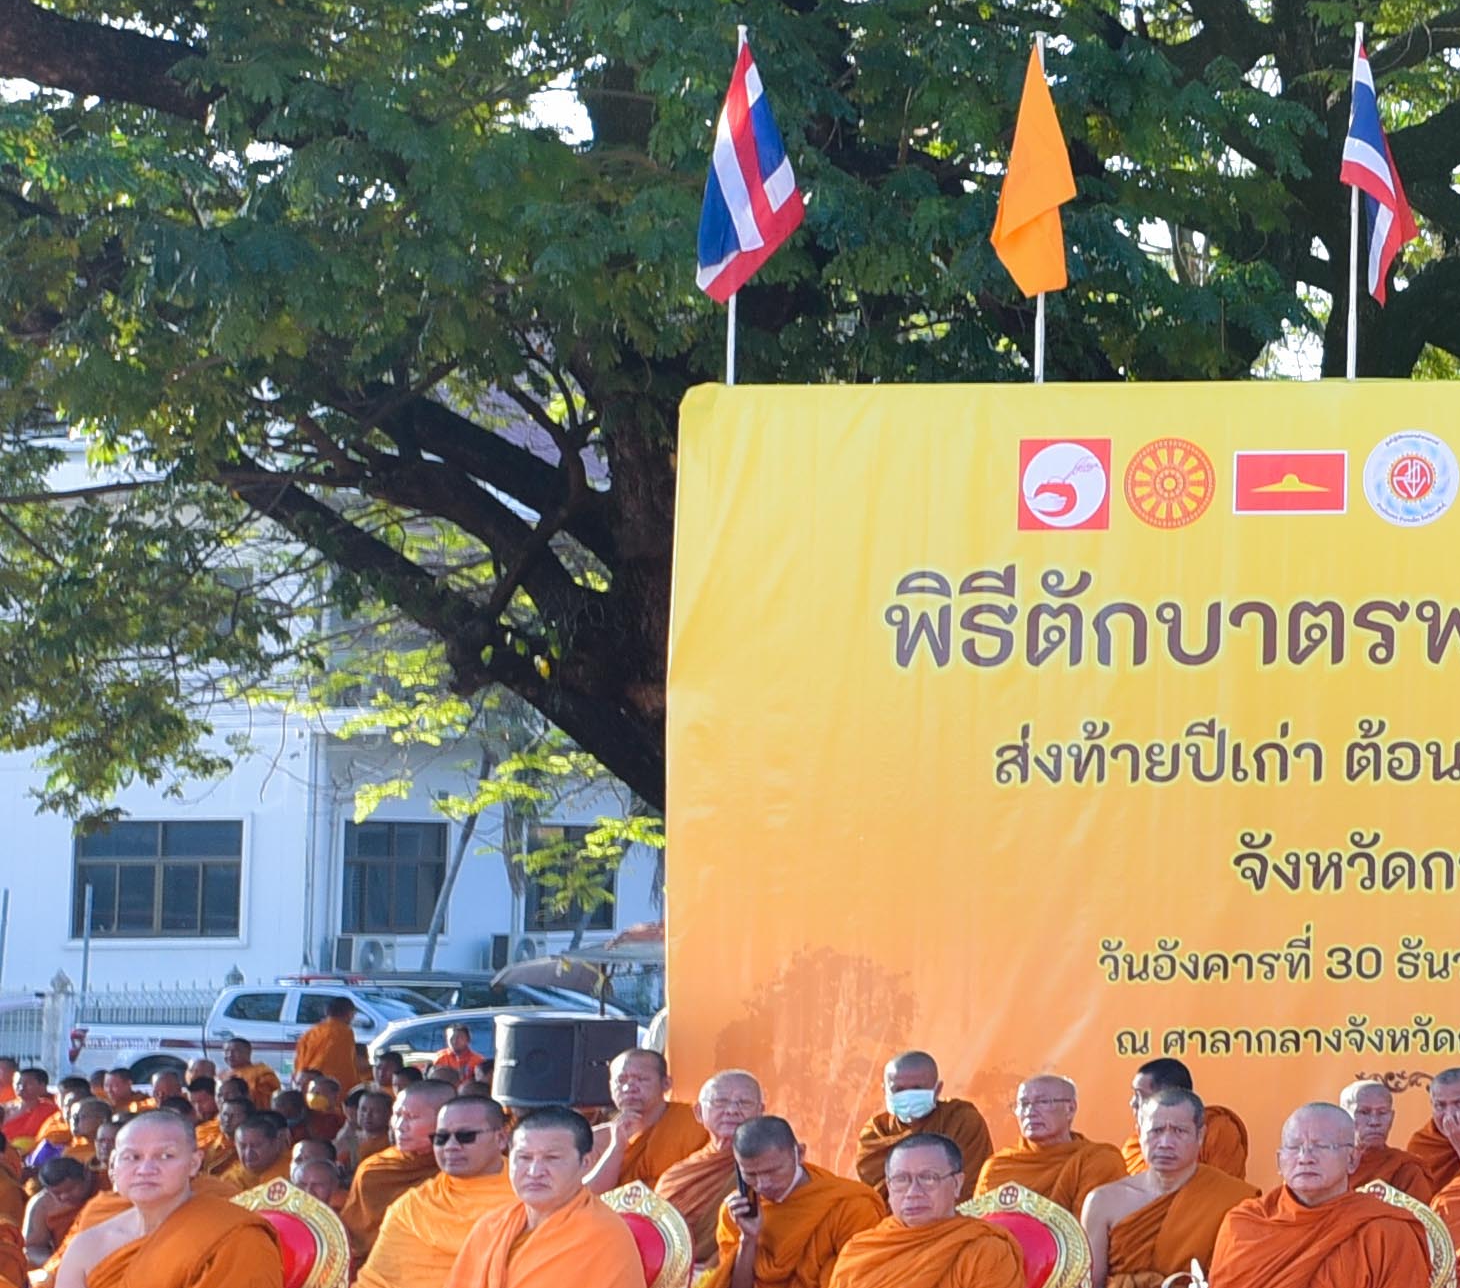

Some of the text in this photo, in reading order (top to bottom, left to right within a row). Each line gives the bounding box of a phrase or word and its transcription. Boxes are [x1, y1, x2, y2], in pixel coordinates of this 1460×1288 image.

[996, 718, 1323, 784] ส่งท้ายปีเก่า
[1099, 924, 1311, 981] วันอังคารที่
[1326, 947, 1382, 980] 30
[1116, 1031, 1149, 1055] ณ
